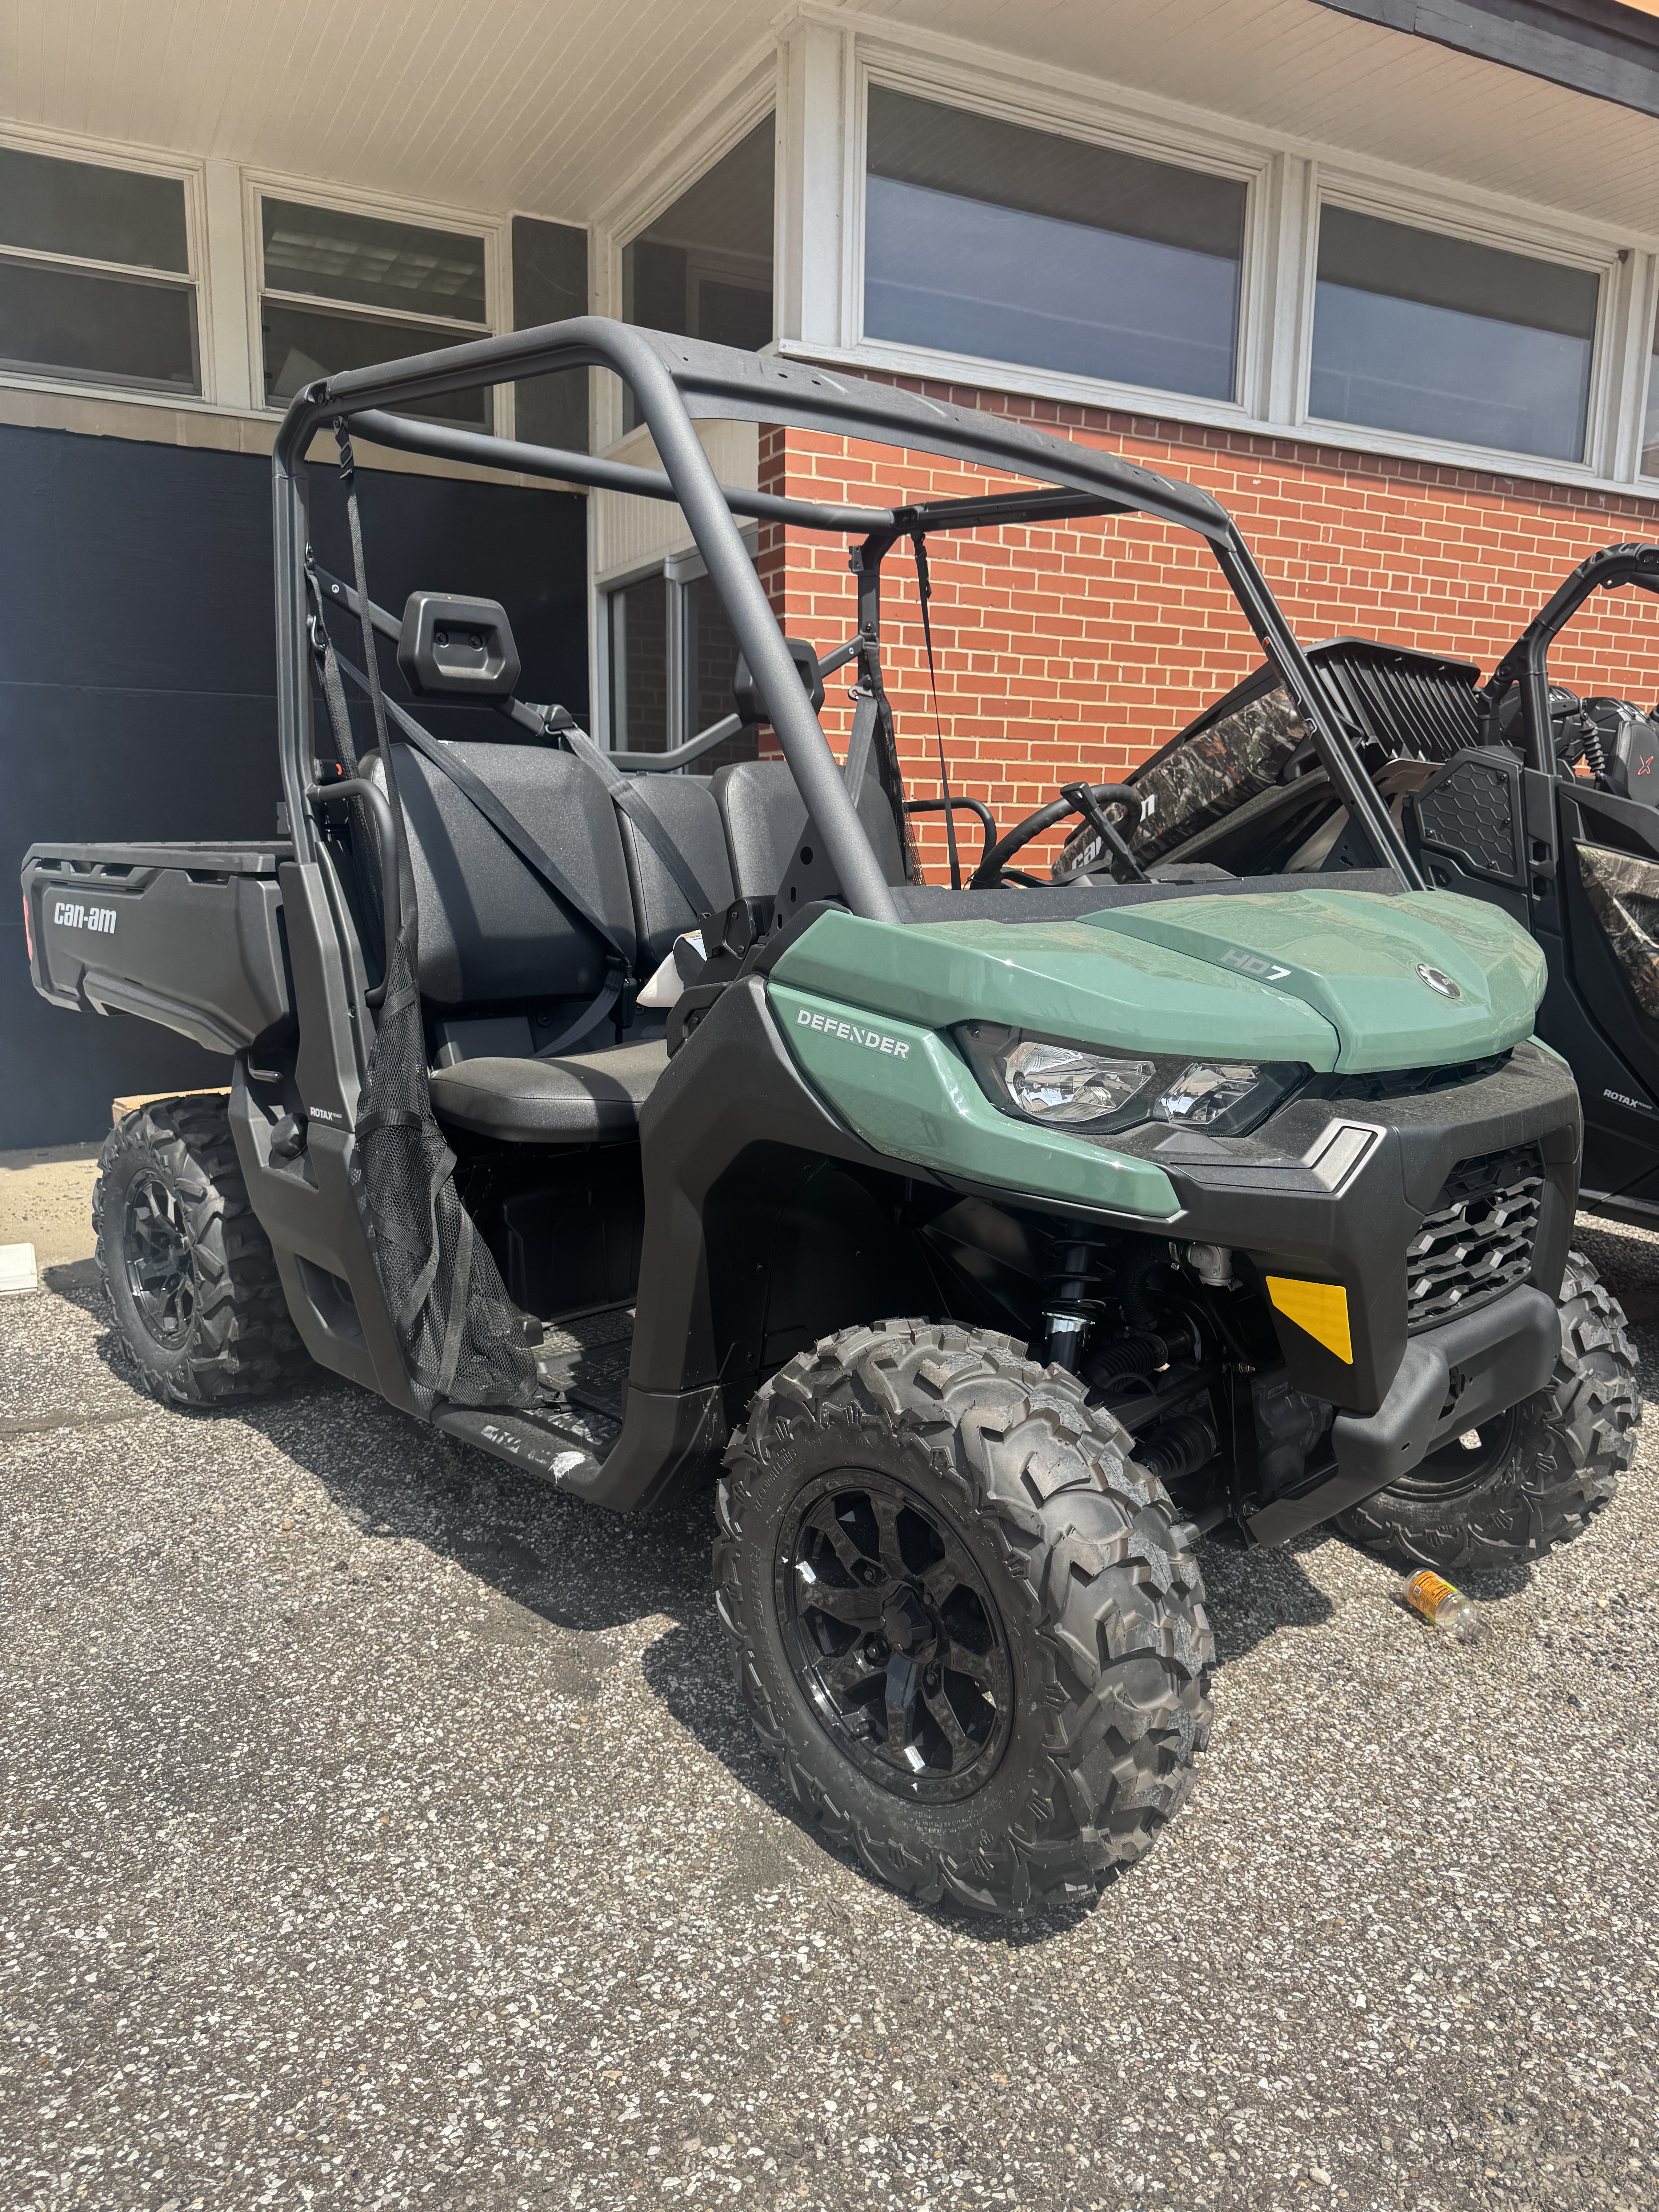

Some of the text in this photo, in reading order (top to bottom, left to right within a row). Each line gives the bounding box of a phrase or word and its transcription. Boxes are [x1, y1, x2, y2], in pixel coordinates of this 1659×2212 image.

[54, 902, 117, 934] can-am
[1219, 948, 1292, 981] HD7
[797, 1009, 910, 1059] DEFENDER
[310, 1107, 333, 1121] ROTAX
[1603, 1089, 1638, 1108] ROTAX
